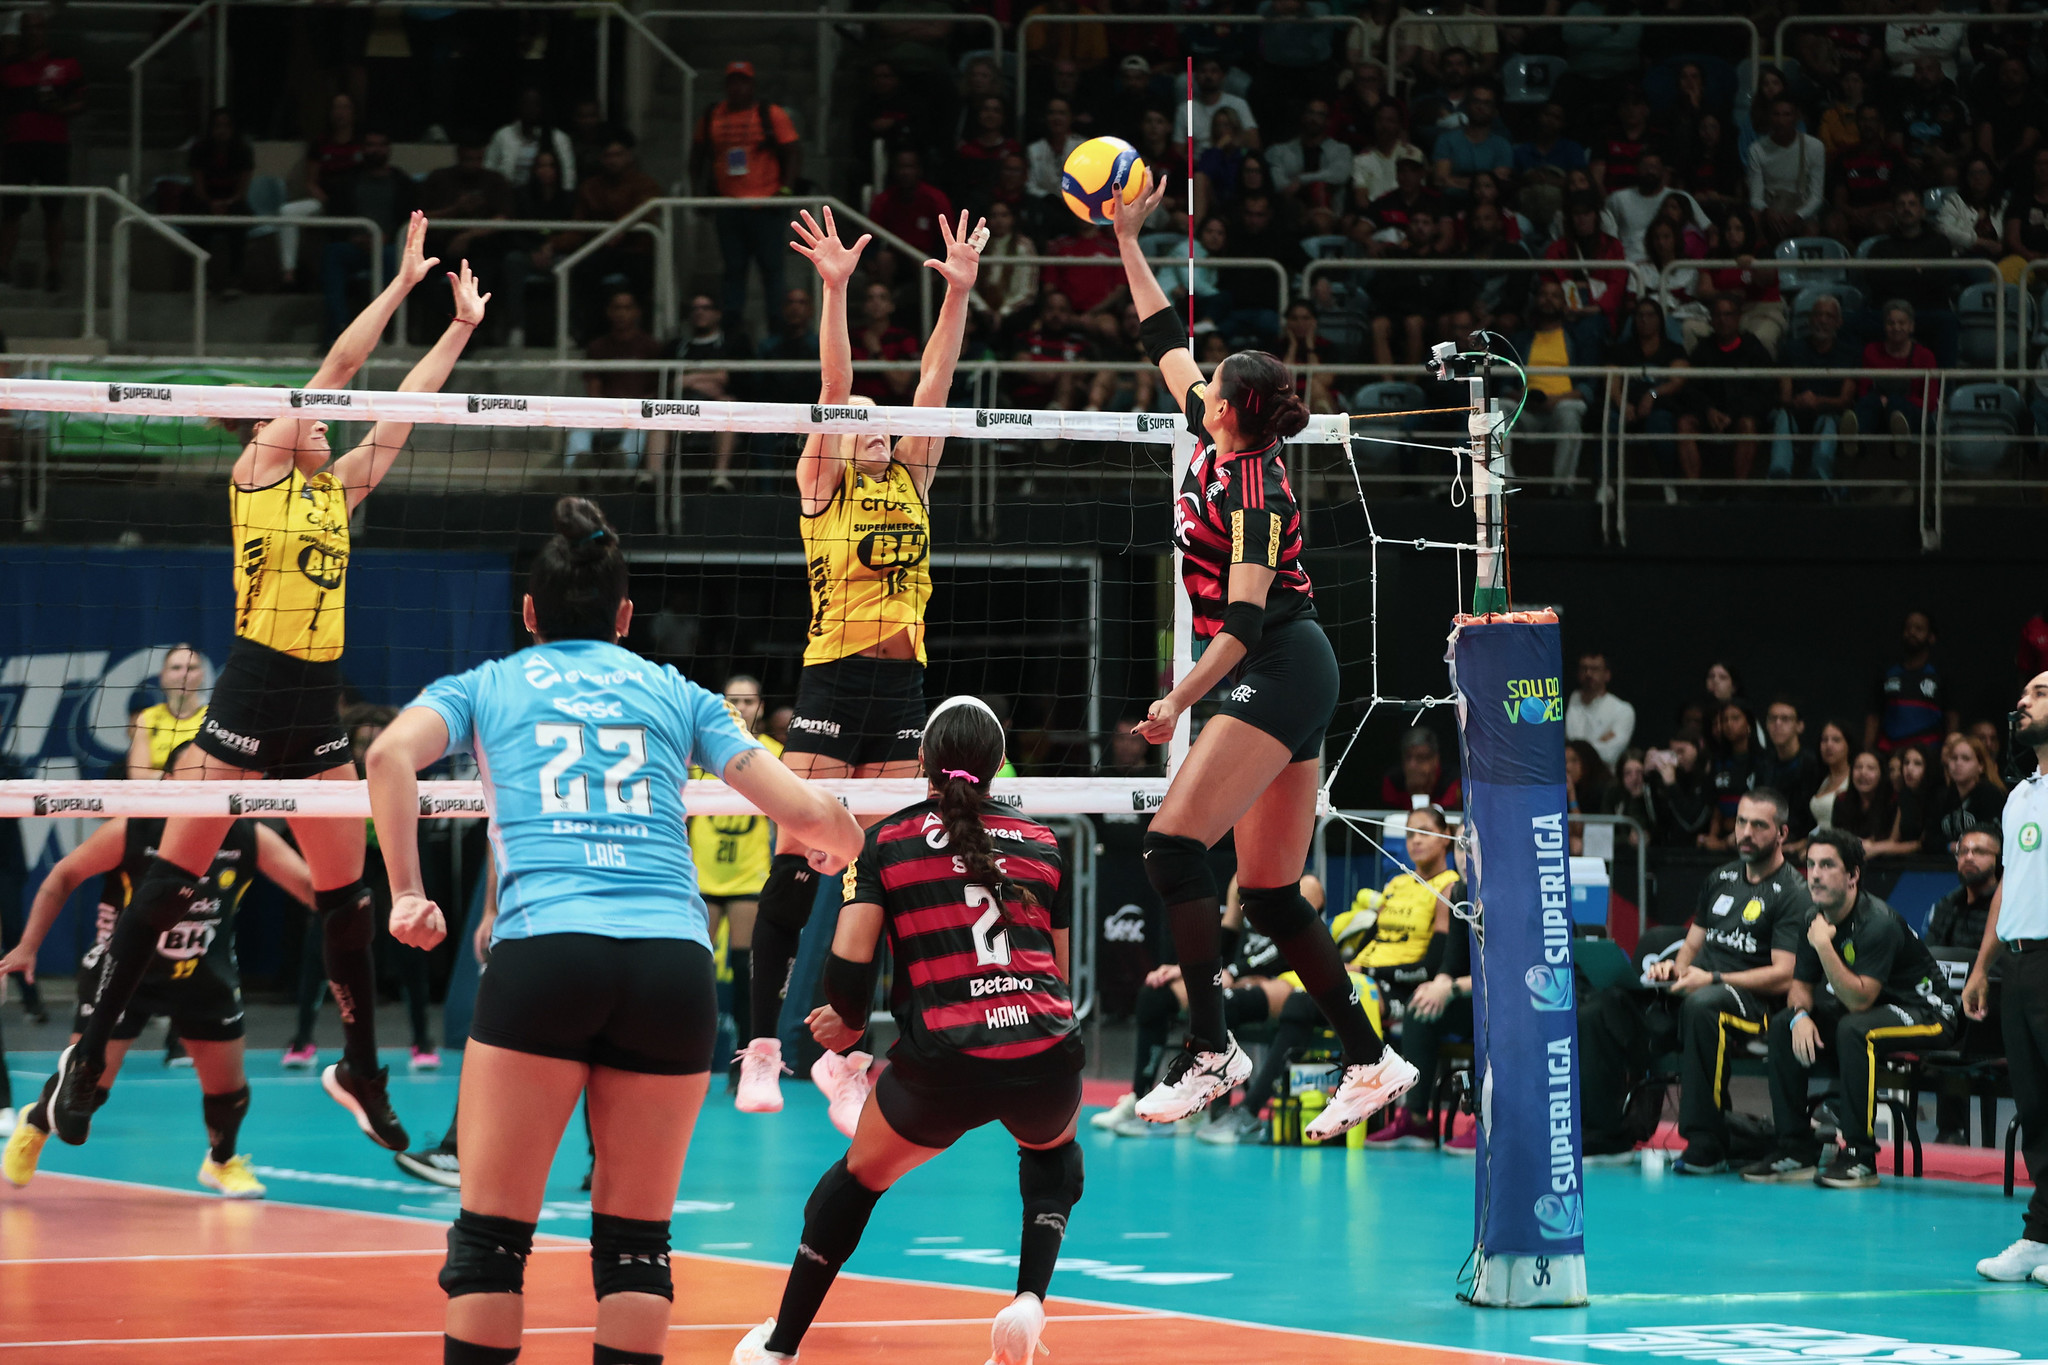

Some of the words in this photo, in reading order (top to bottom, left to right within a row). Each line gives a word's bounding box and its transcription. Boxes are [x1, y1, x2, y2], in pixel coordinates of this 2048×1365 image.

[123, 387, 172, 401] SUPERLIGA
[304, 393, 352, 407] SUPERLIGA
[481, 398, 528, 411] SUPERLIGA
[654, 402, 700, 416] SUPERLIGA
[824, 408, 869, 421] SUPERLIGA
[989, 412, 1033, 427] SUPERLIGA
[870, 534, 926, 566] BH
[1507, 679, 1544, 698] SOU
[1545, 676, 1559, 697] DO
[535, 722, 653, 816] 22
[50, 798, 104, 813] SUPERLIGA
[244, 798, 298, 813] SUPERLIGA
[434, 799, 486, 813] SUPERLIGA
[1532, 811, 1570, 965] SUPERLIGA
[964, 883, 1012, 966] 2
[969, 976, 1033, 997] Betano
[1547, 1036, 1577, 1193] SUPERLIGA
